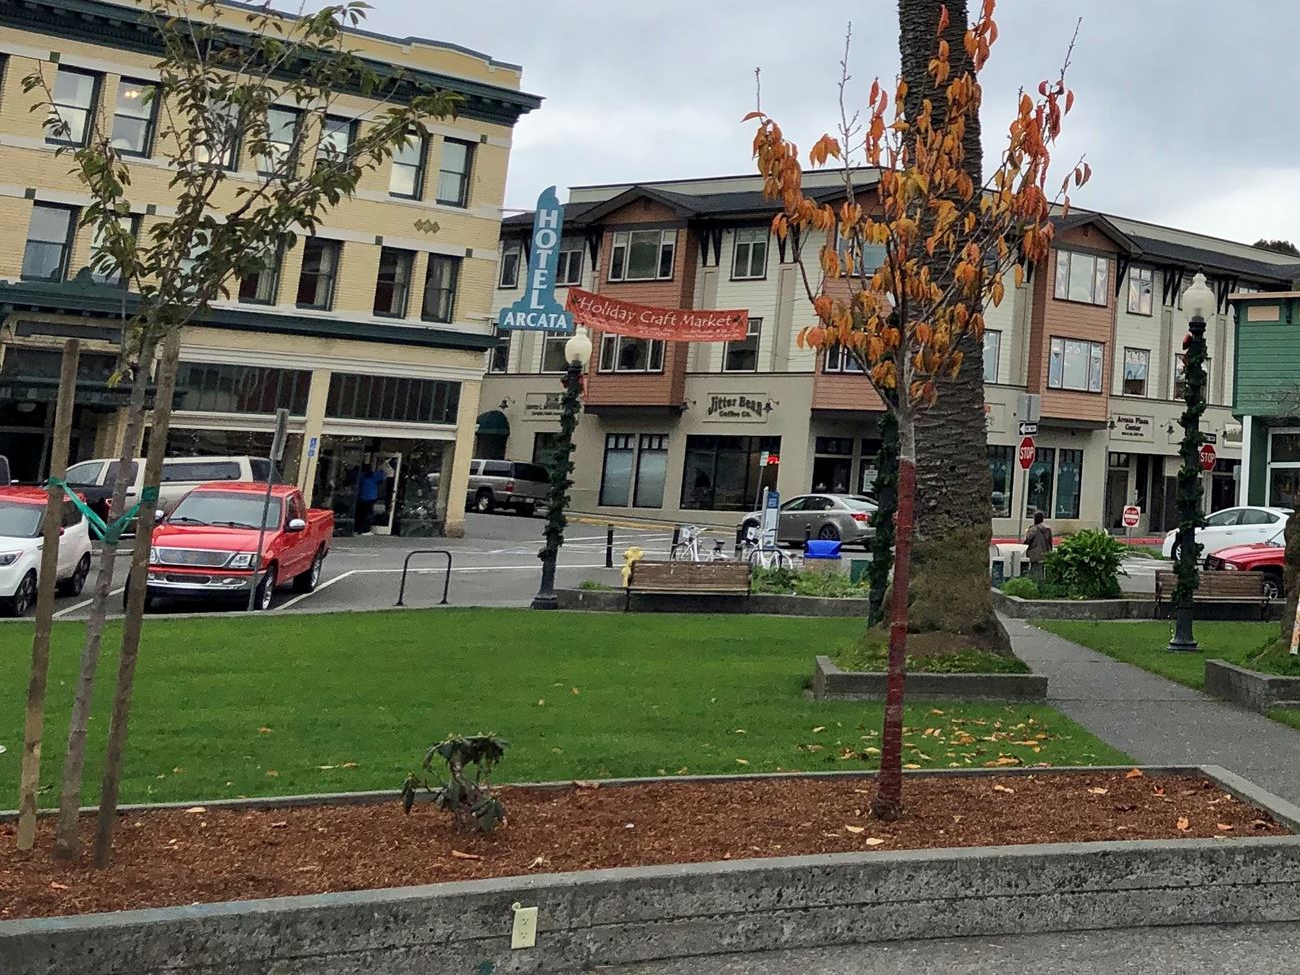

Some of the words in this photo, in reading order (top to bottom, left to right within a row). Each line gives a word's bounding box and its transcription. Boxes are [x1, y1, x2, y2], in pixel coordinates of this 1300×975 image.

[529, 208, 559, 310] HOTEL
[503, 311, 568, 329] ARCATA
[579, 296, 636, 324] Holiday
[640, 310, 677, 326] Craft
[682, 314, 733, 328] Market
[707, 396, 737, 415] Jitter
[739, 396, 762, 417] Bean
[1020, 446, 1034, 460] STOP
[1200, 452, 1215, 463] STOP
